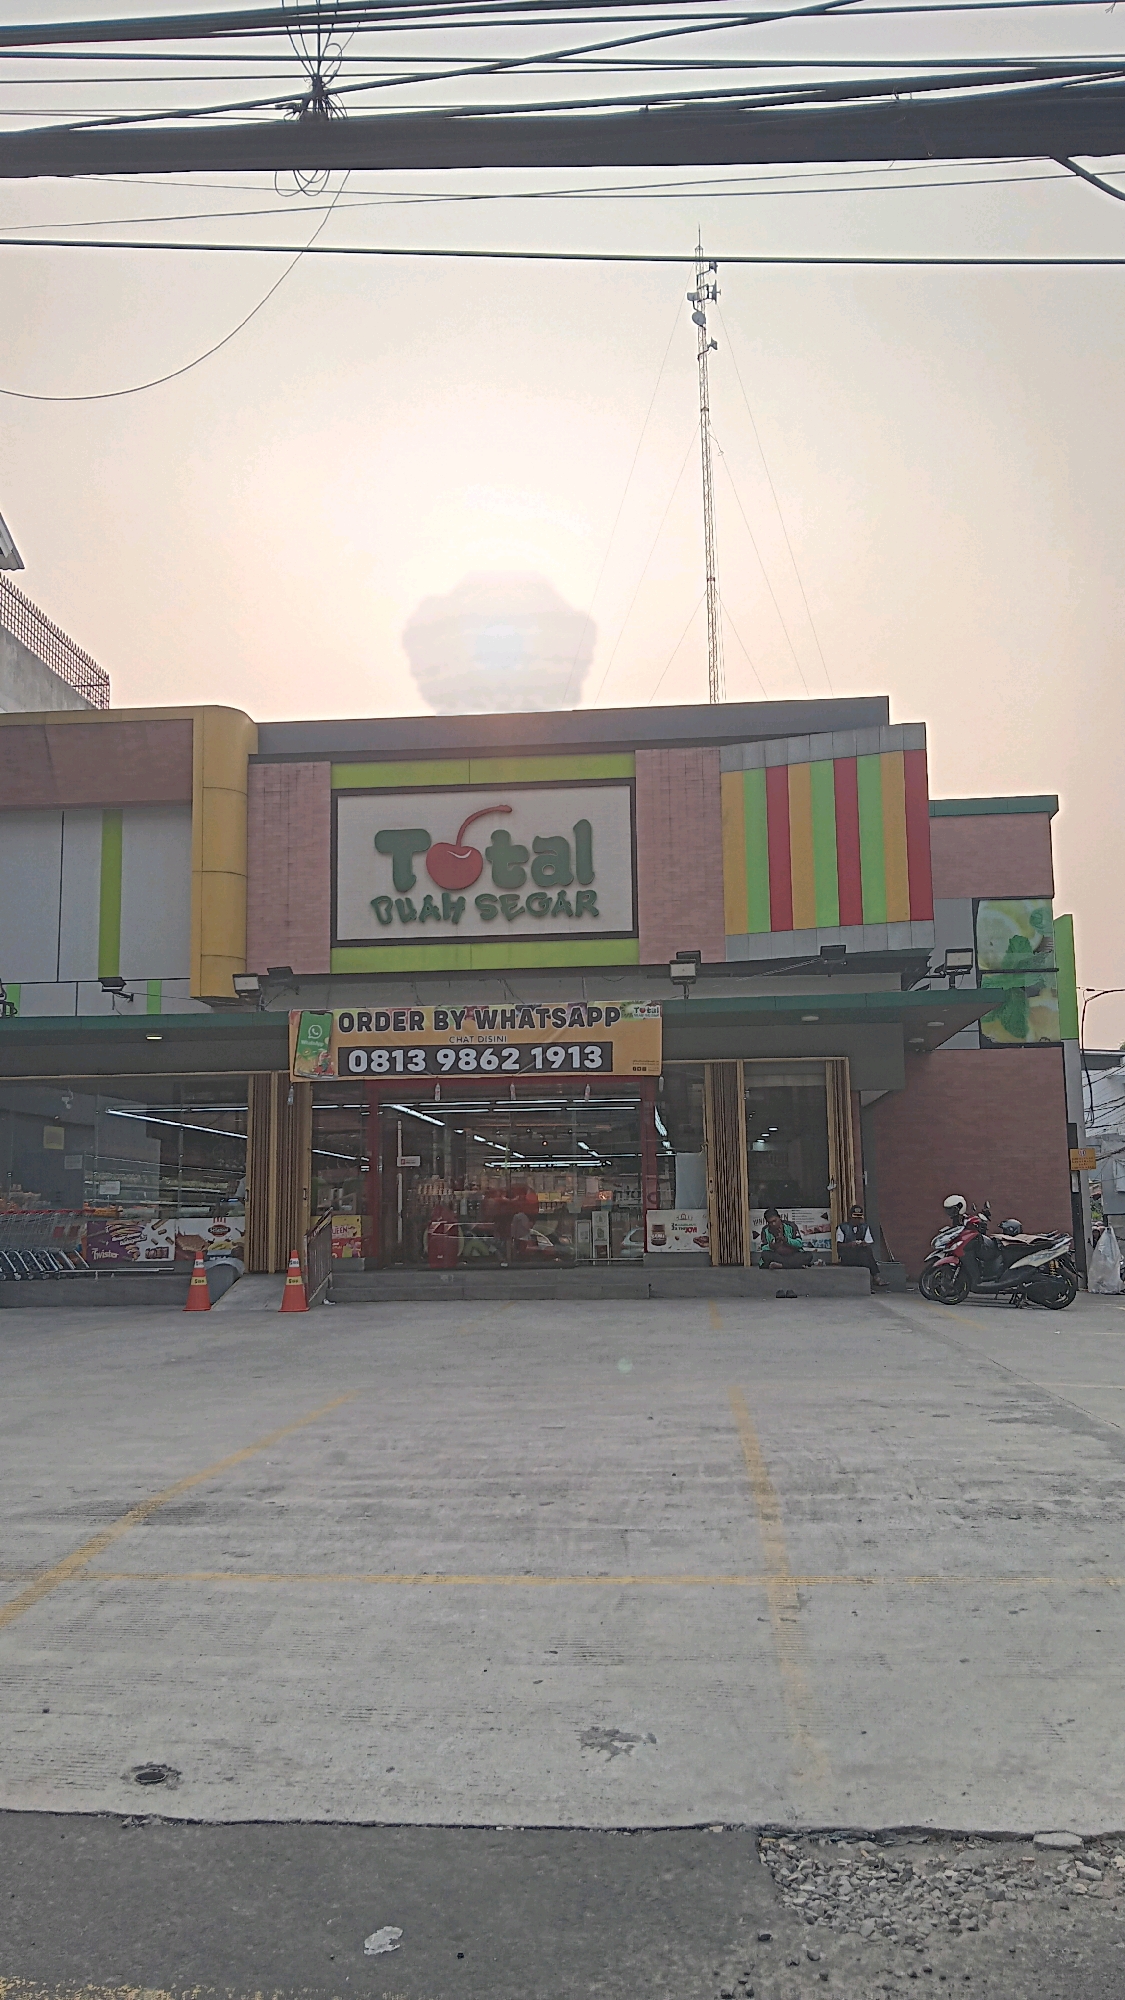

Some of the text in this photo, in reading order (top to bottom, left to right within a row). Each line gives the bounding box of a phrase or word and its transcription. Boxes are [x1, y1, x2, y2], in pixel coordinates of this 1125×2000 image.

[374, 805, 595, 892] Total
[370, 889, 600, 924] BUAH SEGAR
[338, 1005, 621, 1033] ORDER BY WHATSAPP
[449, 1035, 507, 1044] CHAT DISINI
[348, 1045, 603, 1073] 0813 9862 1913
